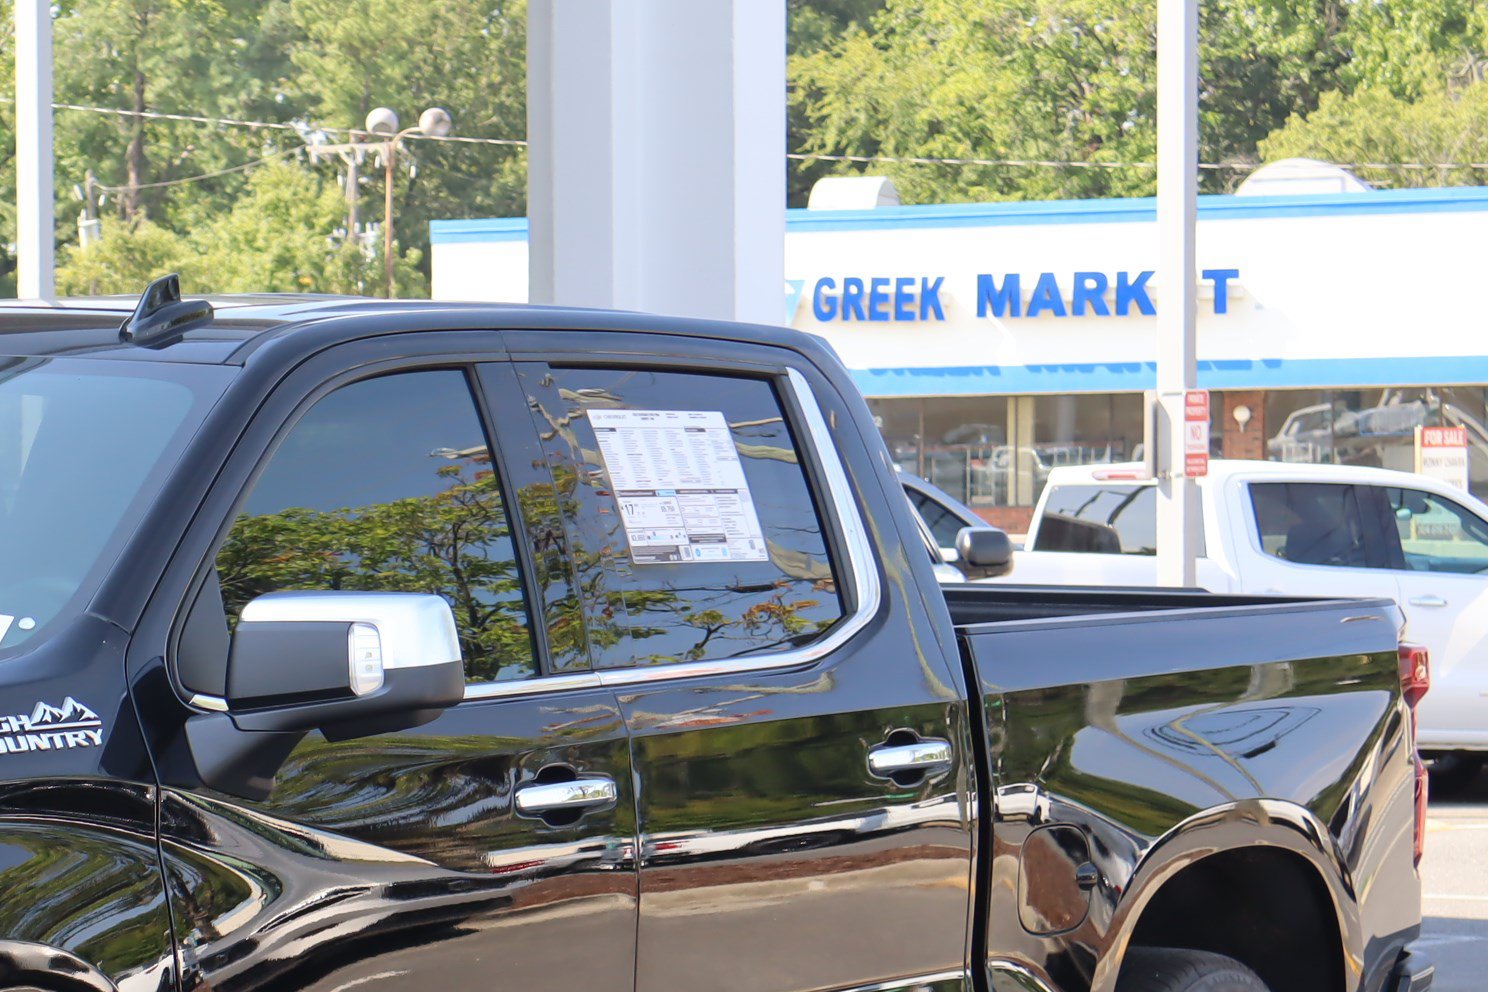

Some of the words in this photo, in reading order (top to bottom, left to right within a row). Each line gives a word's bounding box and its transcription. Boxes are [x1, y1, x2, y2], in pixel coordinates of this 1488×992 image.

[812, 276, 946, 322] GREEK
[976, 268, 1240, 318] MARKT
[1424, 429, 1443, 446] FOR
[1443, 429, 1464, 446] SALE
